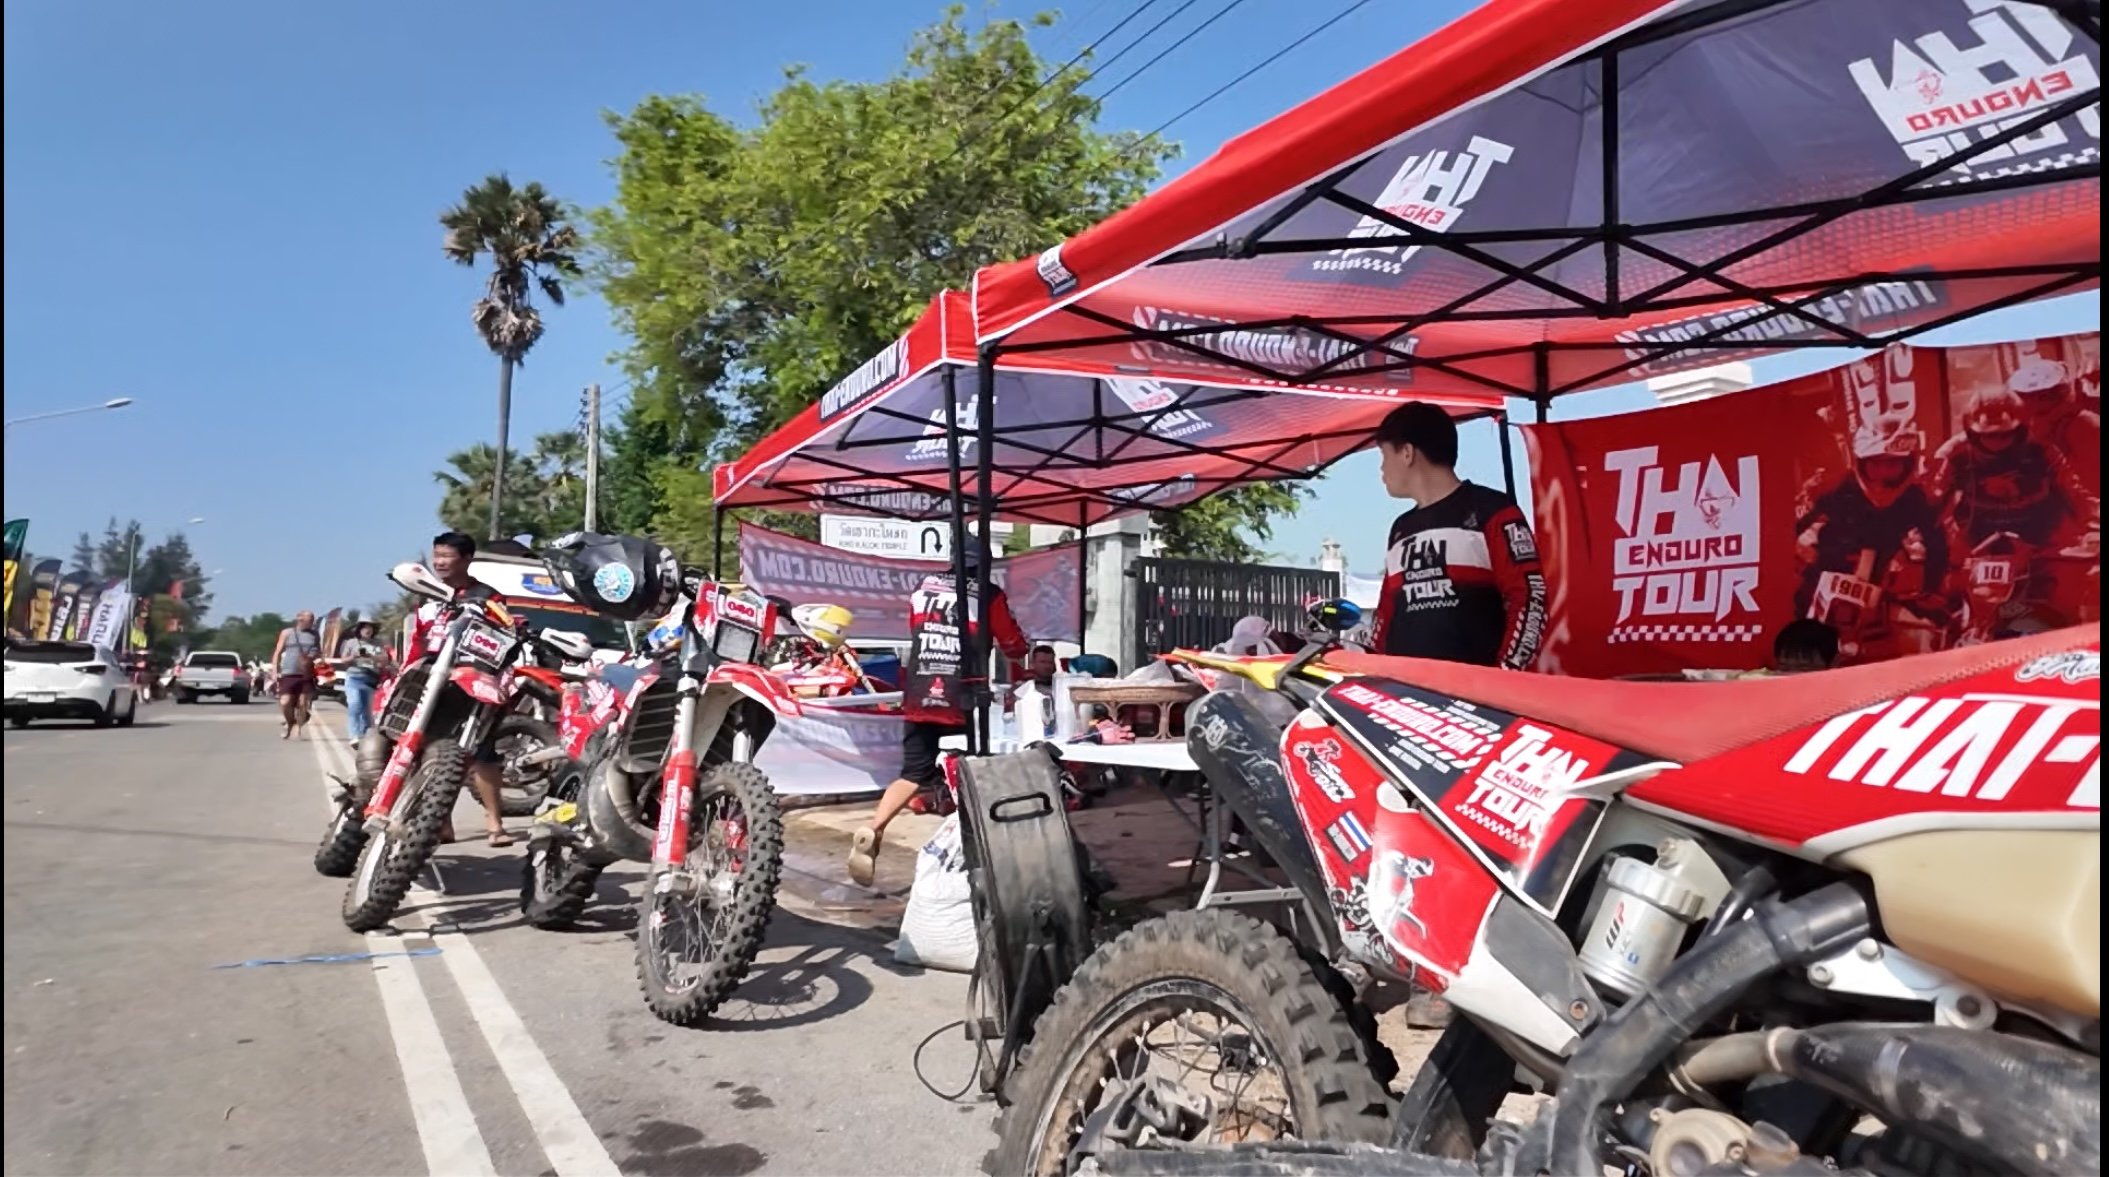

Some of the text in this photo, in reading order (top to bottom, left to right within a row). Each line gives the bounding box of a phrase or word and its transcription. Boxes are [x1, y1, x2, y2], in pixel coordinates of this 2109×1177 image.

[1604, 446, 1760, 537] THAI
[1629, 534, 1742, 568] ENDURO
[1984, 566, 2003, 581] 10
[1402, 579, 1456, 603] TOUR
[1612, 566, 1760, 625] TOUR
[1783, 697, 2100, 807] THAI-
